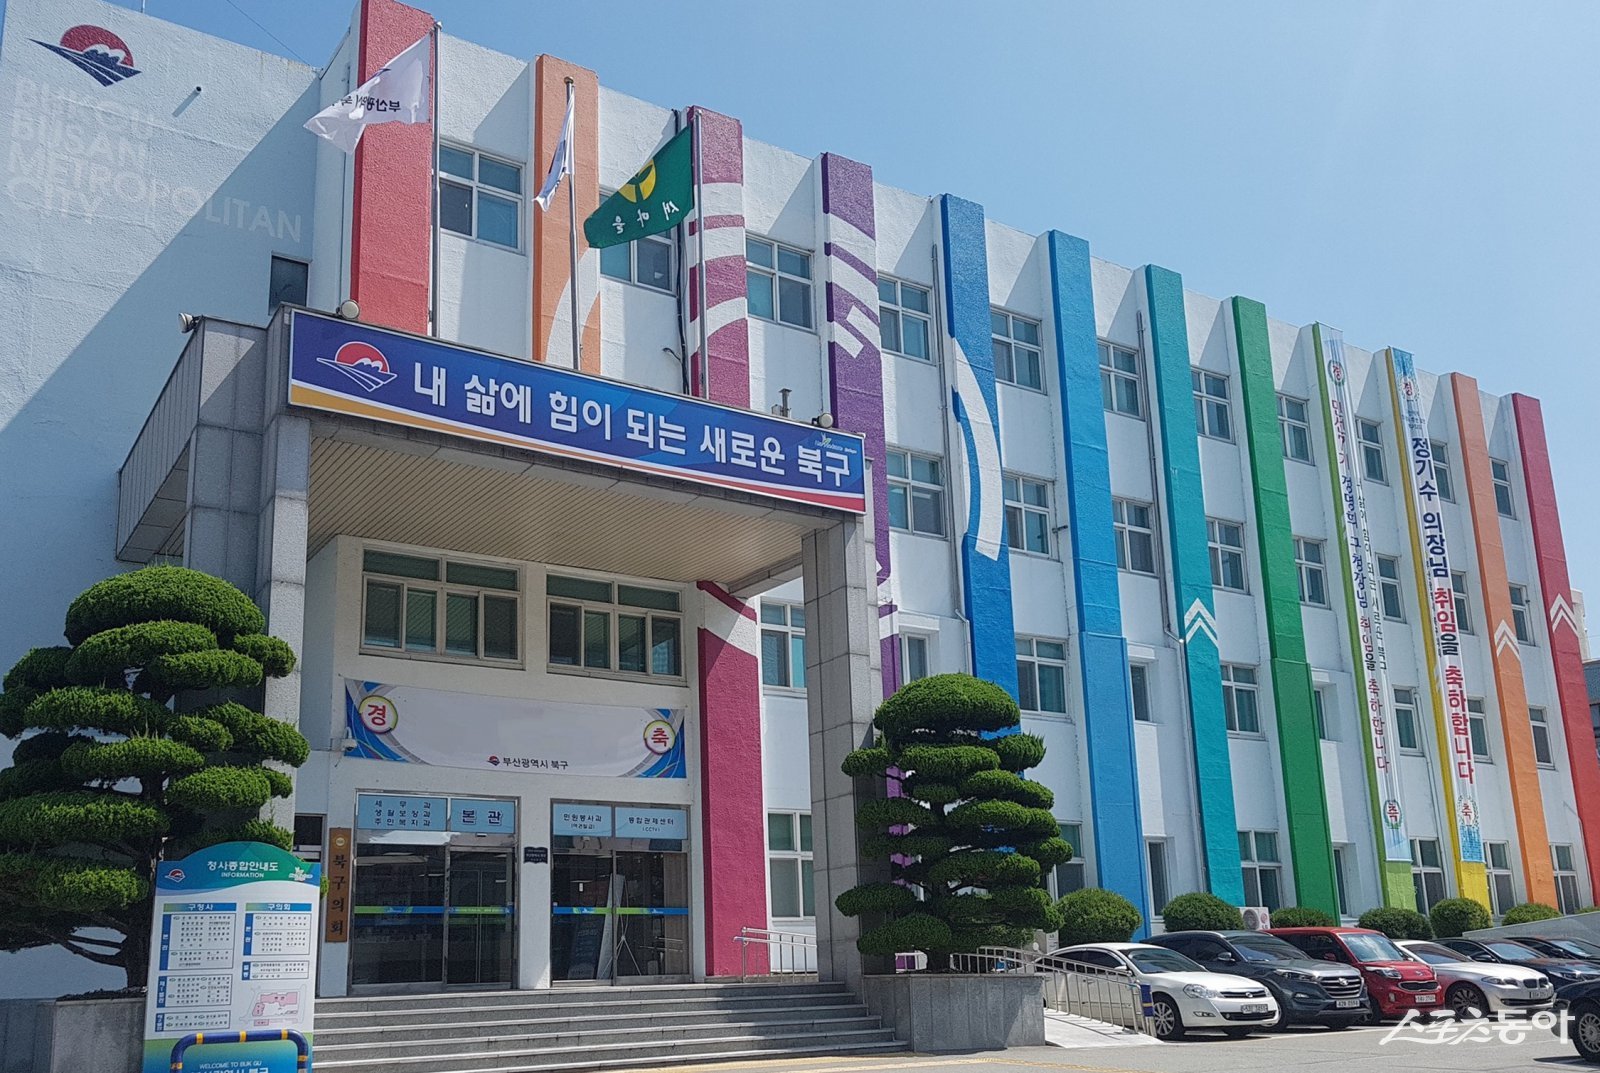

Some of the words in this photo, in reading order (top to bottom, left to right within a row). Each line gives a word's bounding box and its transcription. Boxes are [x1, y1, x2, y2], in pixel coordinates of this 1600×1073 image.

[12, 108, 149, 172] BUSAN
[6, 176, 104, 226] CITY
[8, 141, 302, 243] METROPOLITAN
[413, 361, 447, 405] 내
[464, 374, 532, 424] 삶에
[549, 390, 613, 441] 힘이
[626, 409, 687, 456] 되는
[700, 428, 786, 475] 새로운
[796, 443, 851, 488] 북구
[1412, 436, 1438, 502] 정기수
[1422, 512, 1449, 578] 의장님
[1434, 587, 1460, 656] 취임을
[367, 704, 387, 726] 경
[651, 727, 670, 747] 축
[1445, 665, 1474, 785] 축하합니다
[503, 757, 549, 770] 부산광역시
[551, 760, 569, 770] 북구
